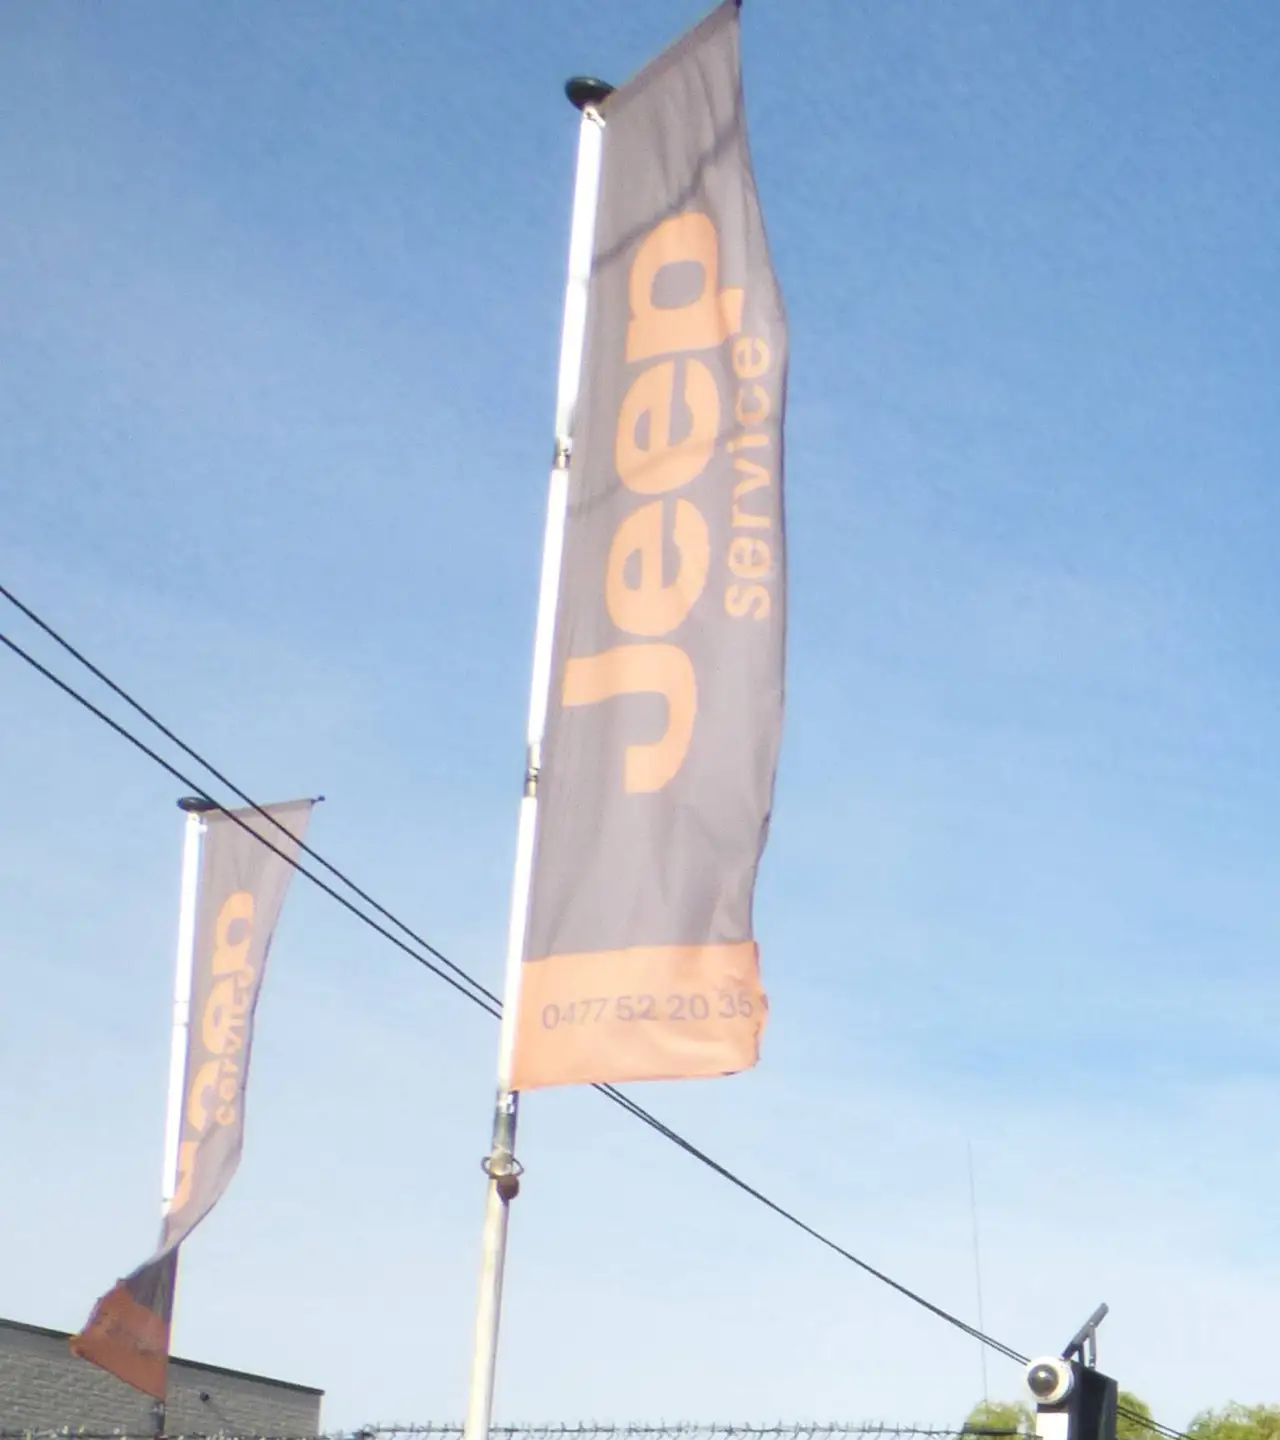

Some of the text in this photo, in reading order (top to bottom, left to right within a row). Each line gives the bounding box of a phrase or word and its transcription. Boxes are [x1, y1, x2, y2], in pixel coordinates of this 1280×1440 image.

[561, 211, 743, 795] Jeep
[722, 336, 771, 622] service
[542, 990, 755, 1030] 0477 52 20 35
